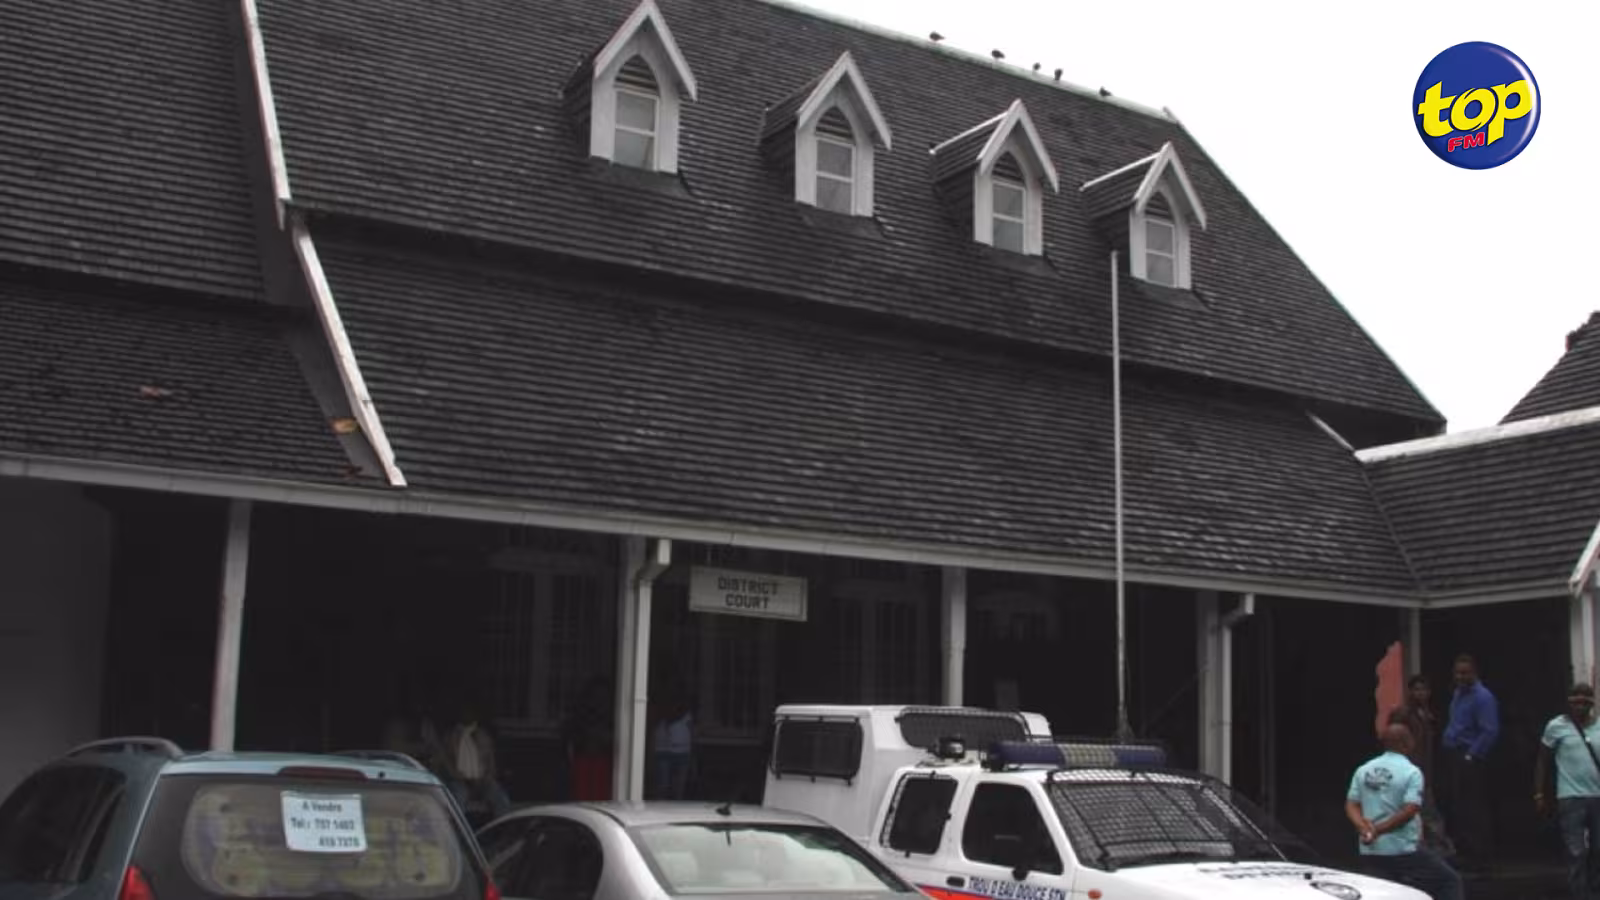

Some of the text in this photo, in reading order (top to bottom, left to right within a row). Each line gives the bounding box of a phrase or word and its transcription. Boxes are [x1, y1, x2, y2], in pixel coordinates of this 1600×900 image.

[718, 577, 778, 595] DISTRICT
[725, 594, 769, 609] COURT
[969, 876, 989, 893] TROU
[997, 880, 1017, 898] EAU
[1016, 883, 1048, 900] DOUCE
